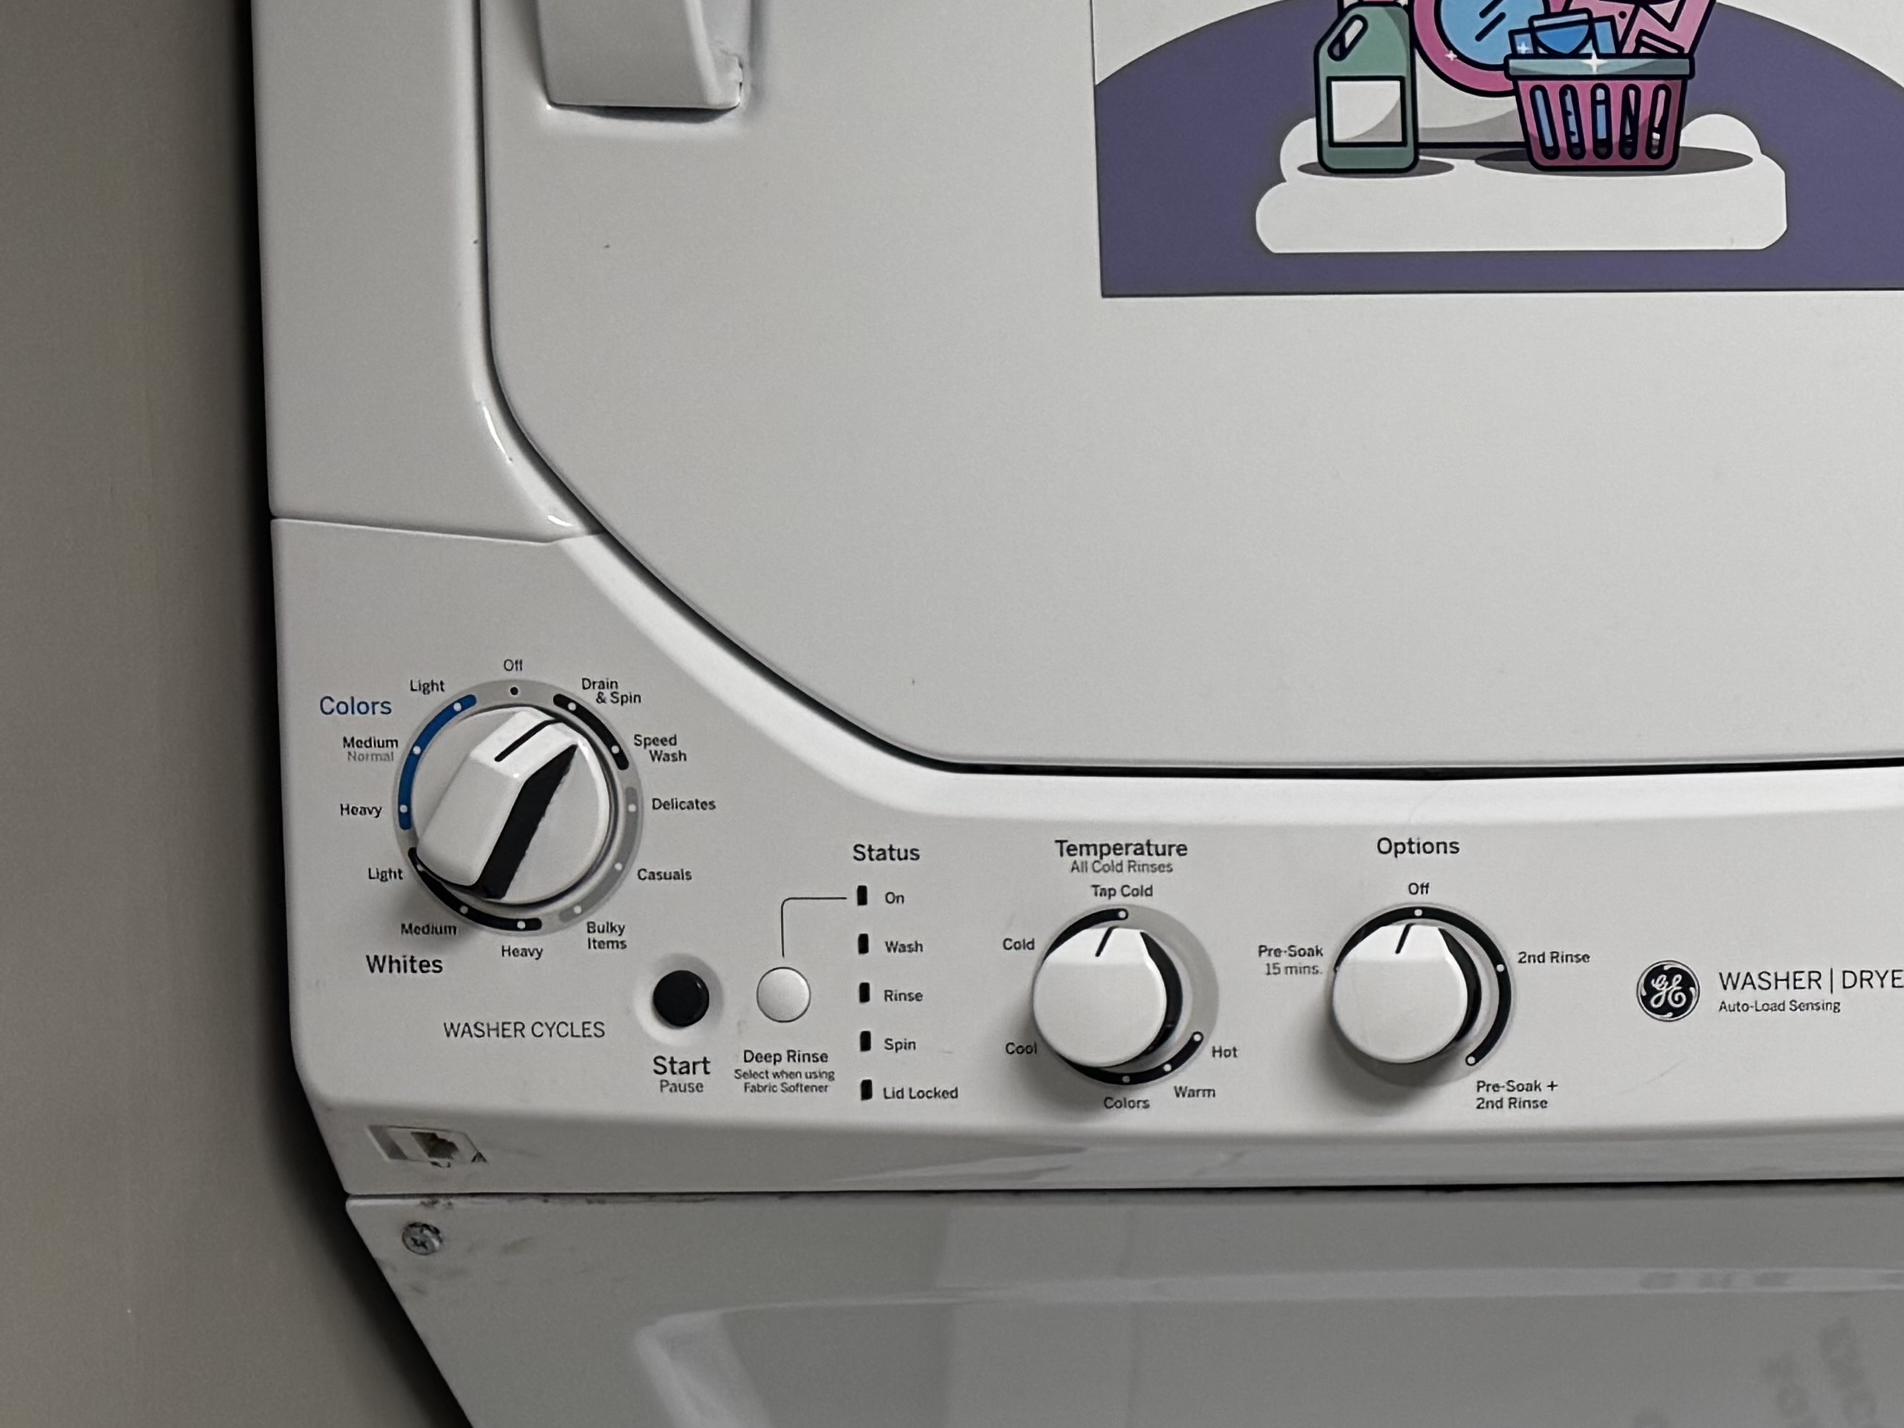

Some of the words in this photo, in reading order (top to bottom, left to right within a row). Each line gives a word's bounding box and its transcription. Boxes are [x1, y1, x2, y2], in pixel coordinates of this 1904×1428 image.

[504, 659, 522, 671] Off
[410, 680, 444, 695] Light
[582, 678, 618, 690] Drain
[320, 696, 392, 715] Colors
[596, 691, 606, 704] &
[610, 691, 641, 706] Spin
[634, 734, 677, 749] Speed
[649, 750, 687, 762] Wash
[652, 798, 716, 810] Delicates
[853, 844, 920, 861] Status
[1054, 839, 1188, 860] Temperature
[1377, 837, 1459, 858] Options
[1071, 860, 1088, 873] All
[1092, 857, 1123, 873] Cold
[1127, 860, 1173, 873] Rinses
[1091, 884, 1116, 900] Tap
[1121, 885, 1153, 897] Cold
[1408, 882, 1429, 895] Off
[885, 892, 904, 904] On
[587, 921, 625, 936] Bulky
[588, 938, 627, 950] Items
[885, 940, 923, 953] Wash
[1003, 938, 1035, 950] Cold
[1258, 945, 1323, 957] Pre-Soak
[366, 955, 443, 973] Whites
[1518, 951, 1545, 964] 2nd
[1550, 951, 1590, 963] Rinse
[1719, 971, 1821, 990] WASHER
[884, 990, 923, 1002] Rinse
[1719, 1000, 1785, 1012] Auto-Load
[1789, 999, 1840, 1013] Sensing
[444, 1021, 525, 1038] WASHER
[531, 1021, 605, 1038] CYCLES
[884, 1038, 916, 1053] Spin
[1212, 1046, 1237, 1058] Hot
[744, 1050, 782, 1066] Deep
[787, 1049, 828, 1063] Rinse
[653, 1056, 710, 1075] Start
[660, 1079, 703, 1093] Pause
[883, 1087, 904, 1099] Lid
[909, 1087, 958, 1099] Locked
[1174, 1086, 1215, 1098] Warm
